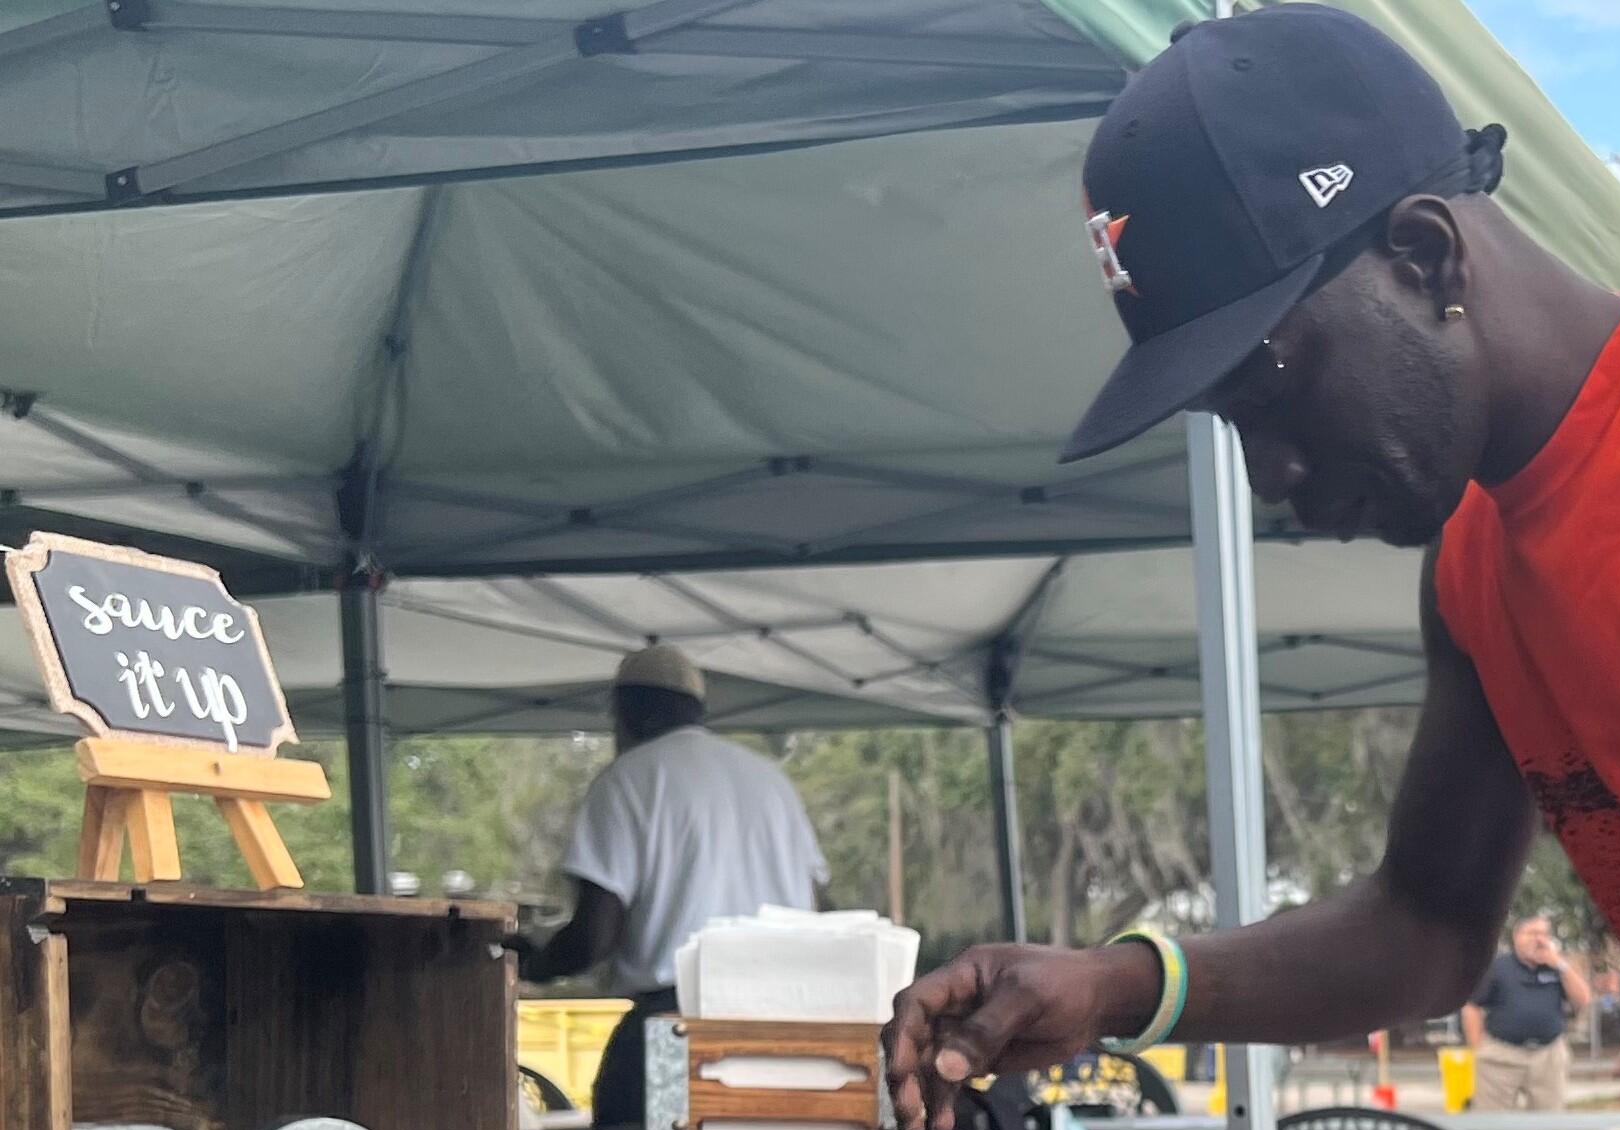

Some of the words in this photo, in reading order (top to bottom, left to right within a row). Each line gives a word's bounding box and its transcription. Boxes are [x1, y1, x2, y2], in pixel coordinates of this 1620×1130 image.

[67, 585, 245, 644] sauce
[115, 650, 176, 719] it
[174, 666, 248, 753] up
